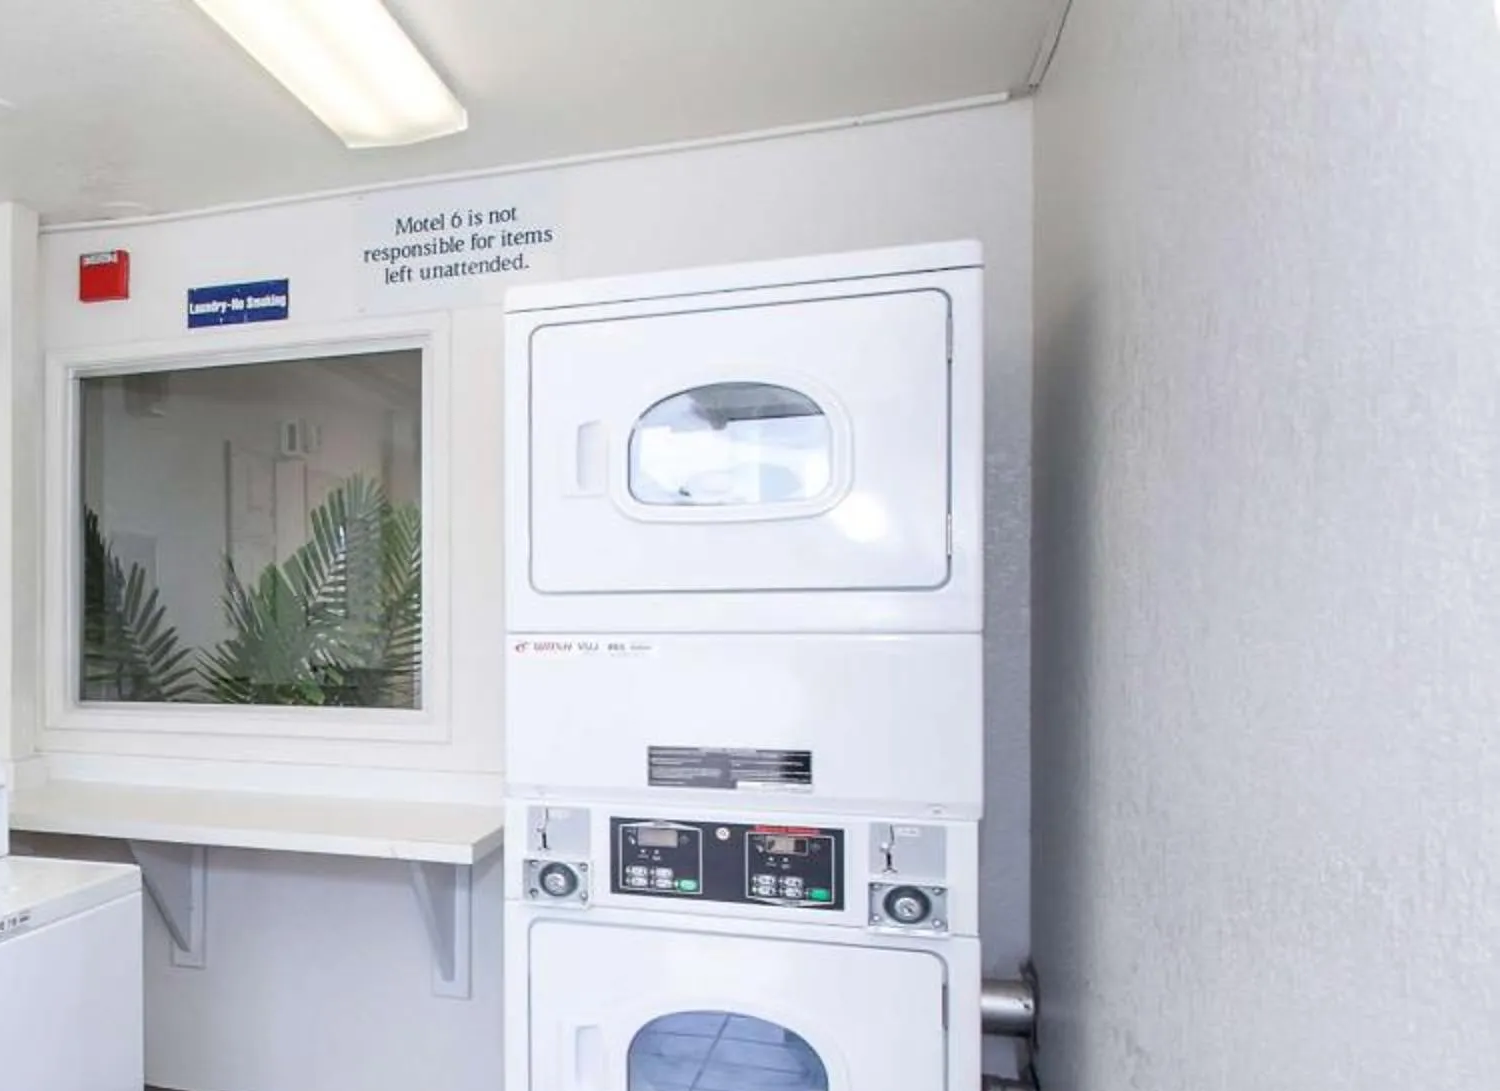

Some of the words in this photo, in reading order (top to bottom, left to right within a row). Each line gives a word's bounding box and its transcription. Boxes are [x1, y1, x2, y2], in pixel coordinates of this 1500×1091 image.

[395, 213, 445, 236] Motel
[451, 210, 463, 228] 6
[468, 209, 483, 227] is
[489, 207, 517, 225] not
[364, 236, 465, 264] responsible
[470, 232, 495, 251] for
[501, 228, 553, 248] items
[385, 265, 412, 285] left
[419, 253, 530, 281] unattended.
